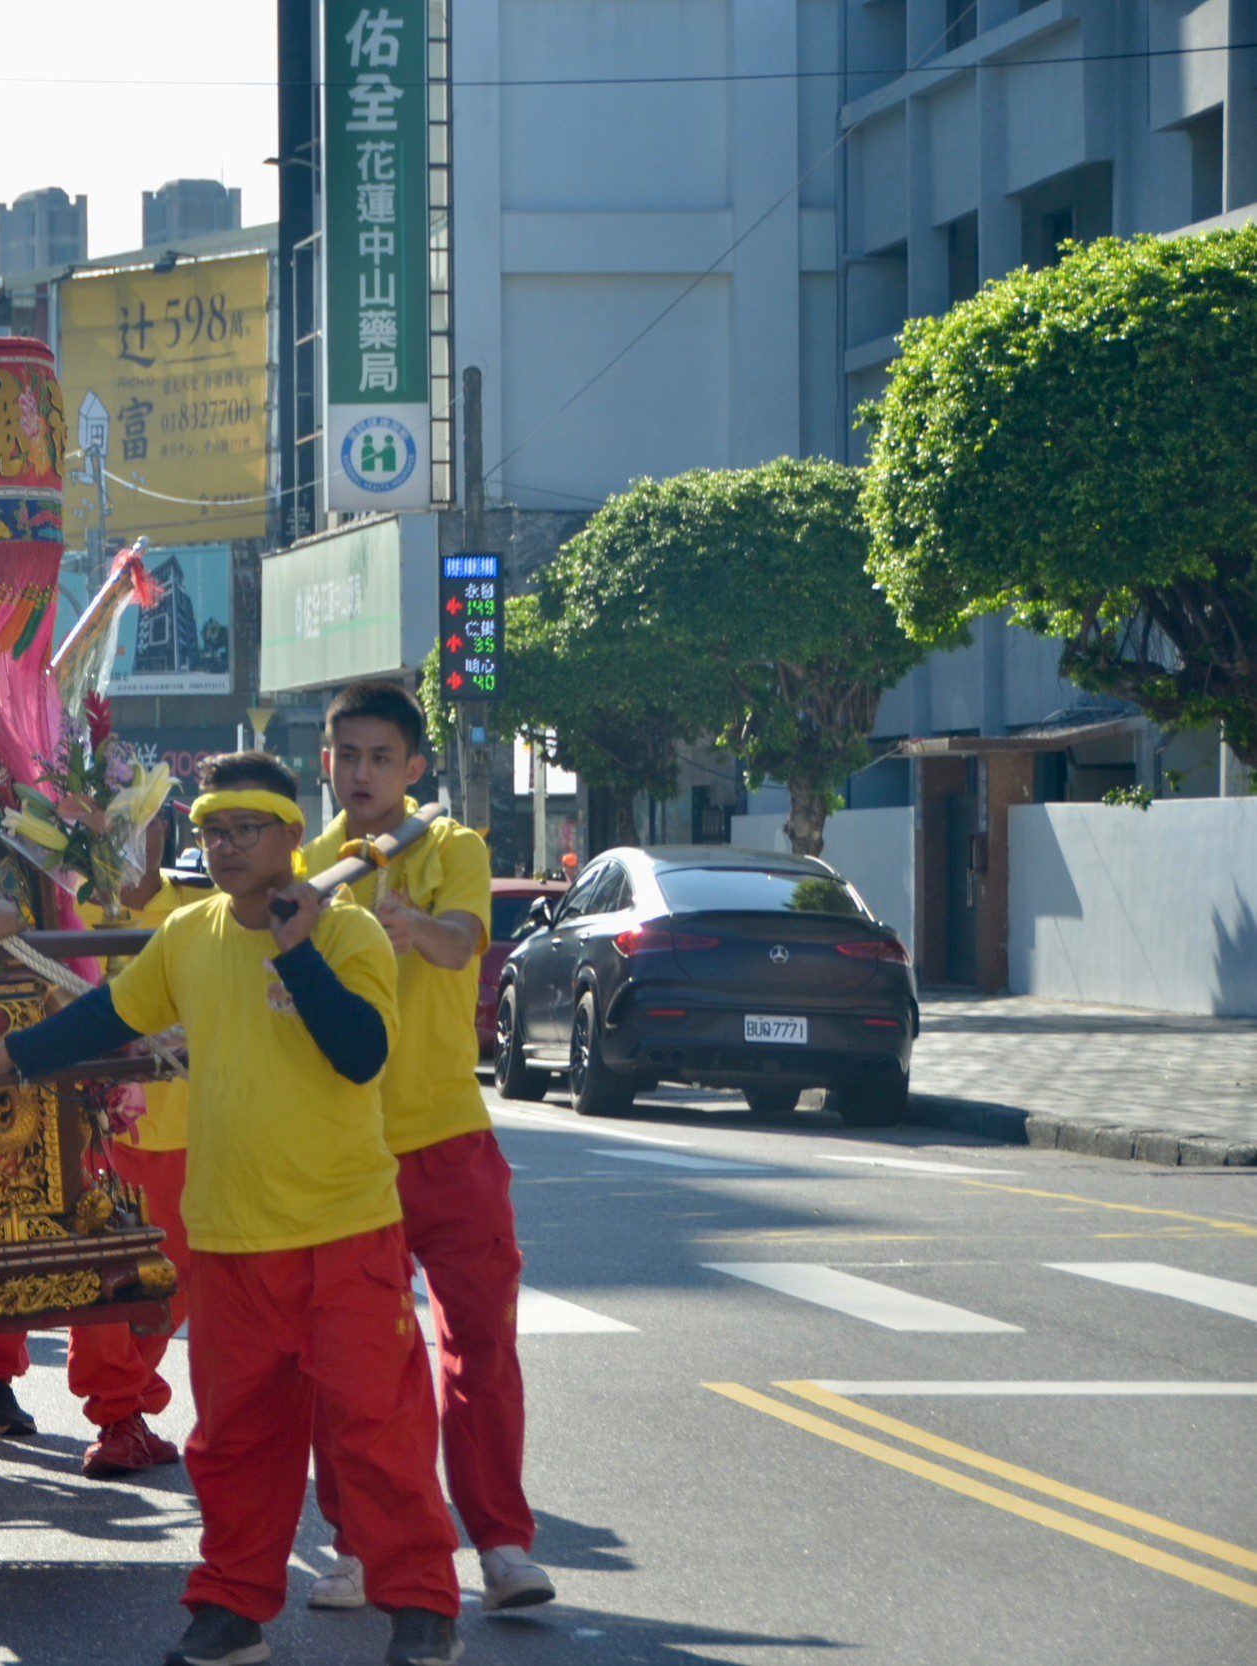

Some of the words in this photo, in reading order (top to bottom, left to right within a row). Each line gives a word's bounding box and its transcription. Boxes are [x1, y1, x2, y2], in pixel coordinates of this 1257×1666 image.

[345, 9, 404, 393] 佑全花蓮中山藥局
[118, 397, 153, 462] 富
[473, 674, 495, 691] 40
